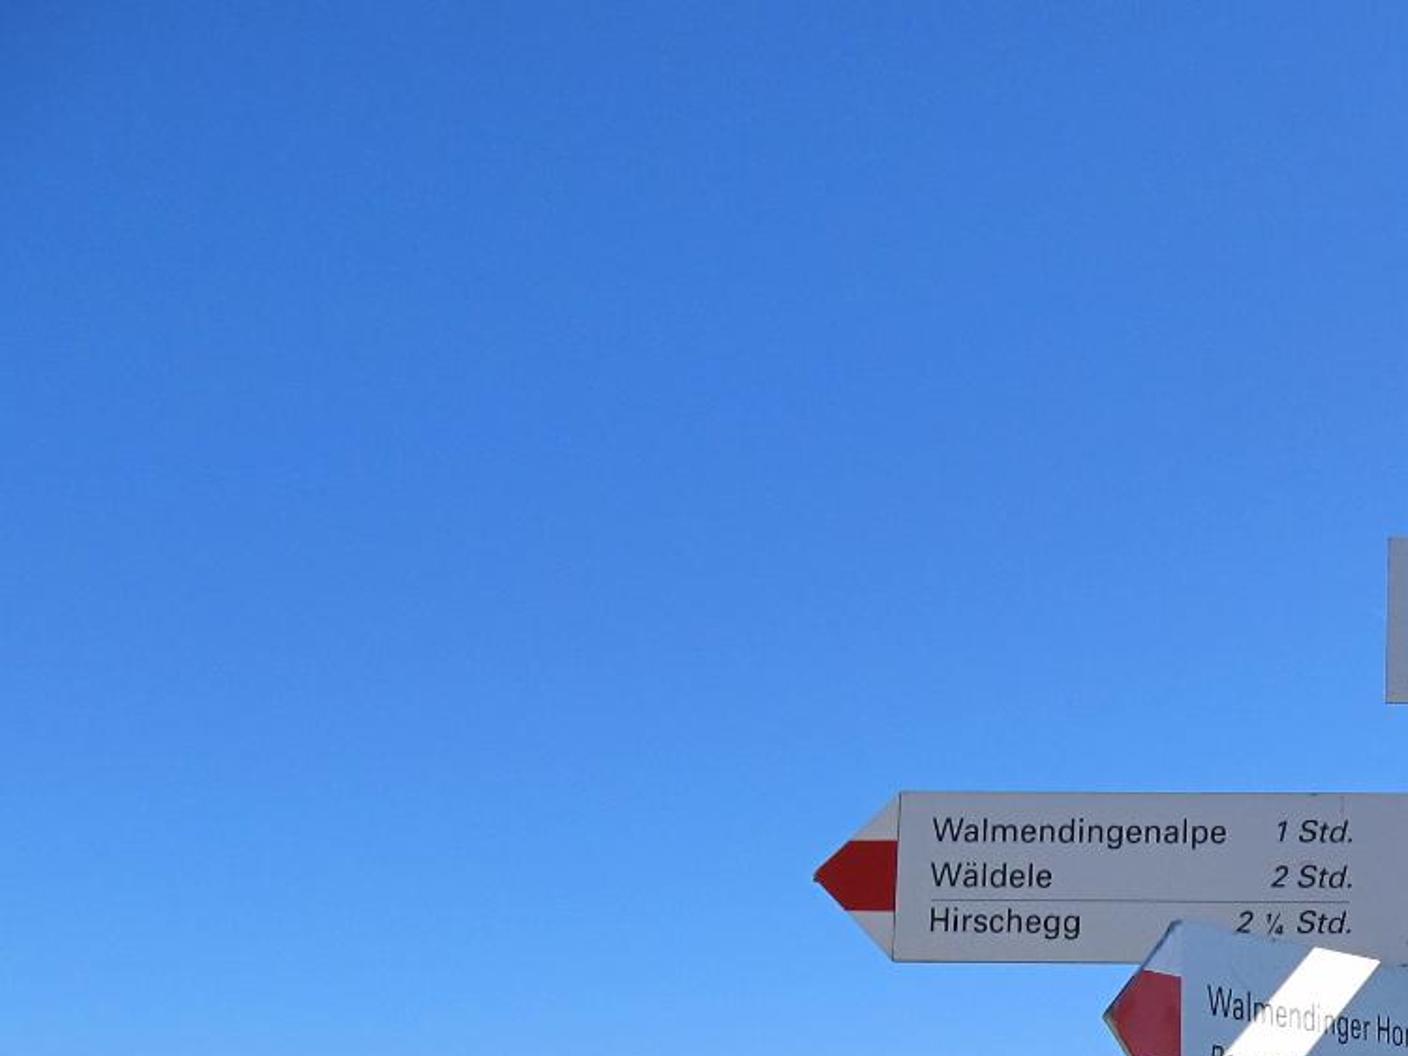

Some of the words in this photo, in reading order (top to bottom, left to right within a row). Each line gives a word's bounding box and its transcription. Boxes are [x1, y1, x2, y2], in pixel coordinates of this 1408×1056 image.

[932, 817, 1228, 850] Walmendingenalpe
[1276, 820, 1288, 842] 1
[1298, 819, 1354, 844] Std.
[930, 861, 1053, 889] Wäldele
[1270, 864, 1289, 888] 2
[1297, 864, 1354, 889] Std.
[930, 906, 1081, 940] Hirschegg
[1296, 909, 1351, 935] Std.
[1206, 983, 1372, 1045] Walmendinger
